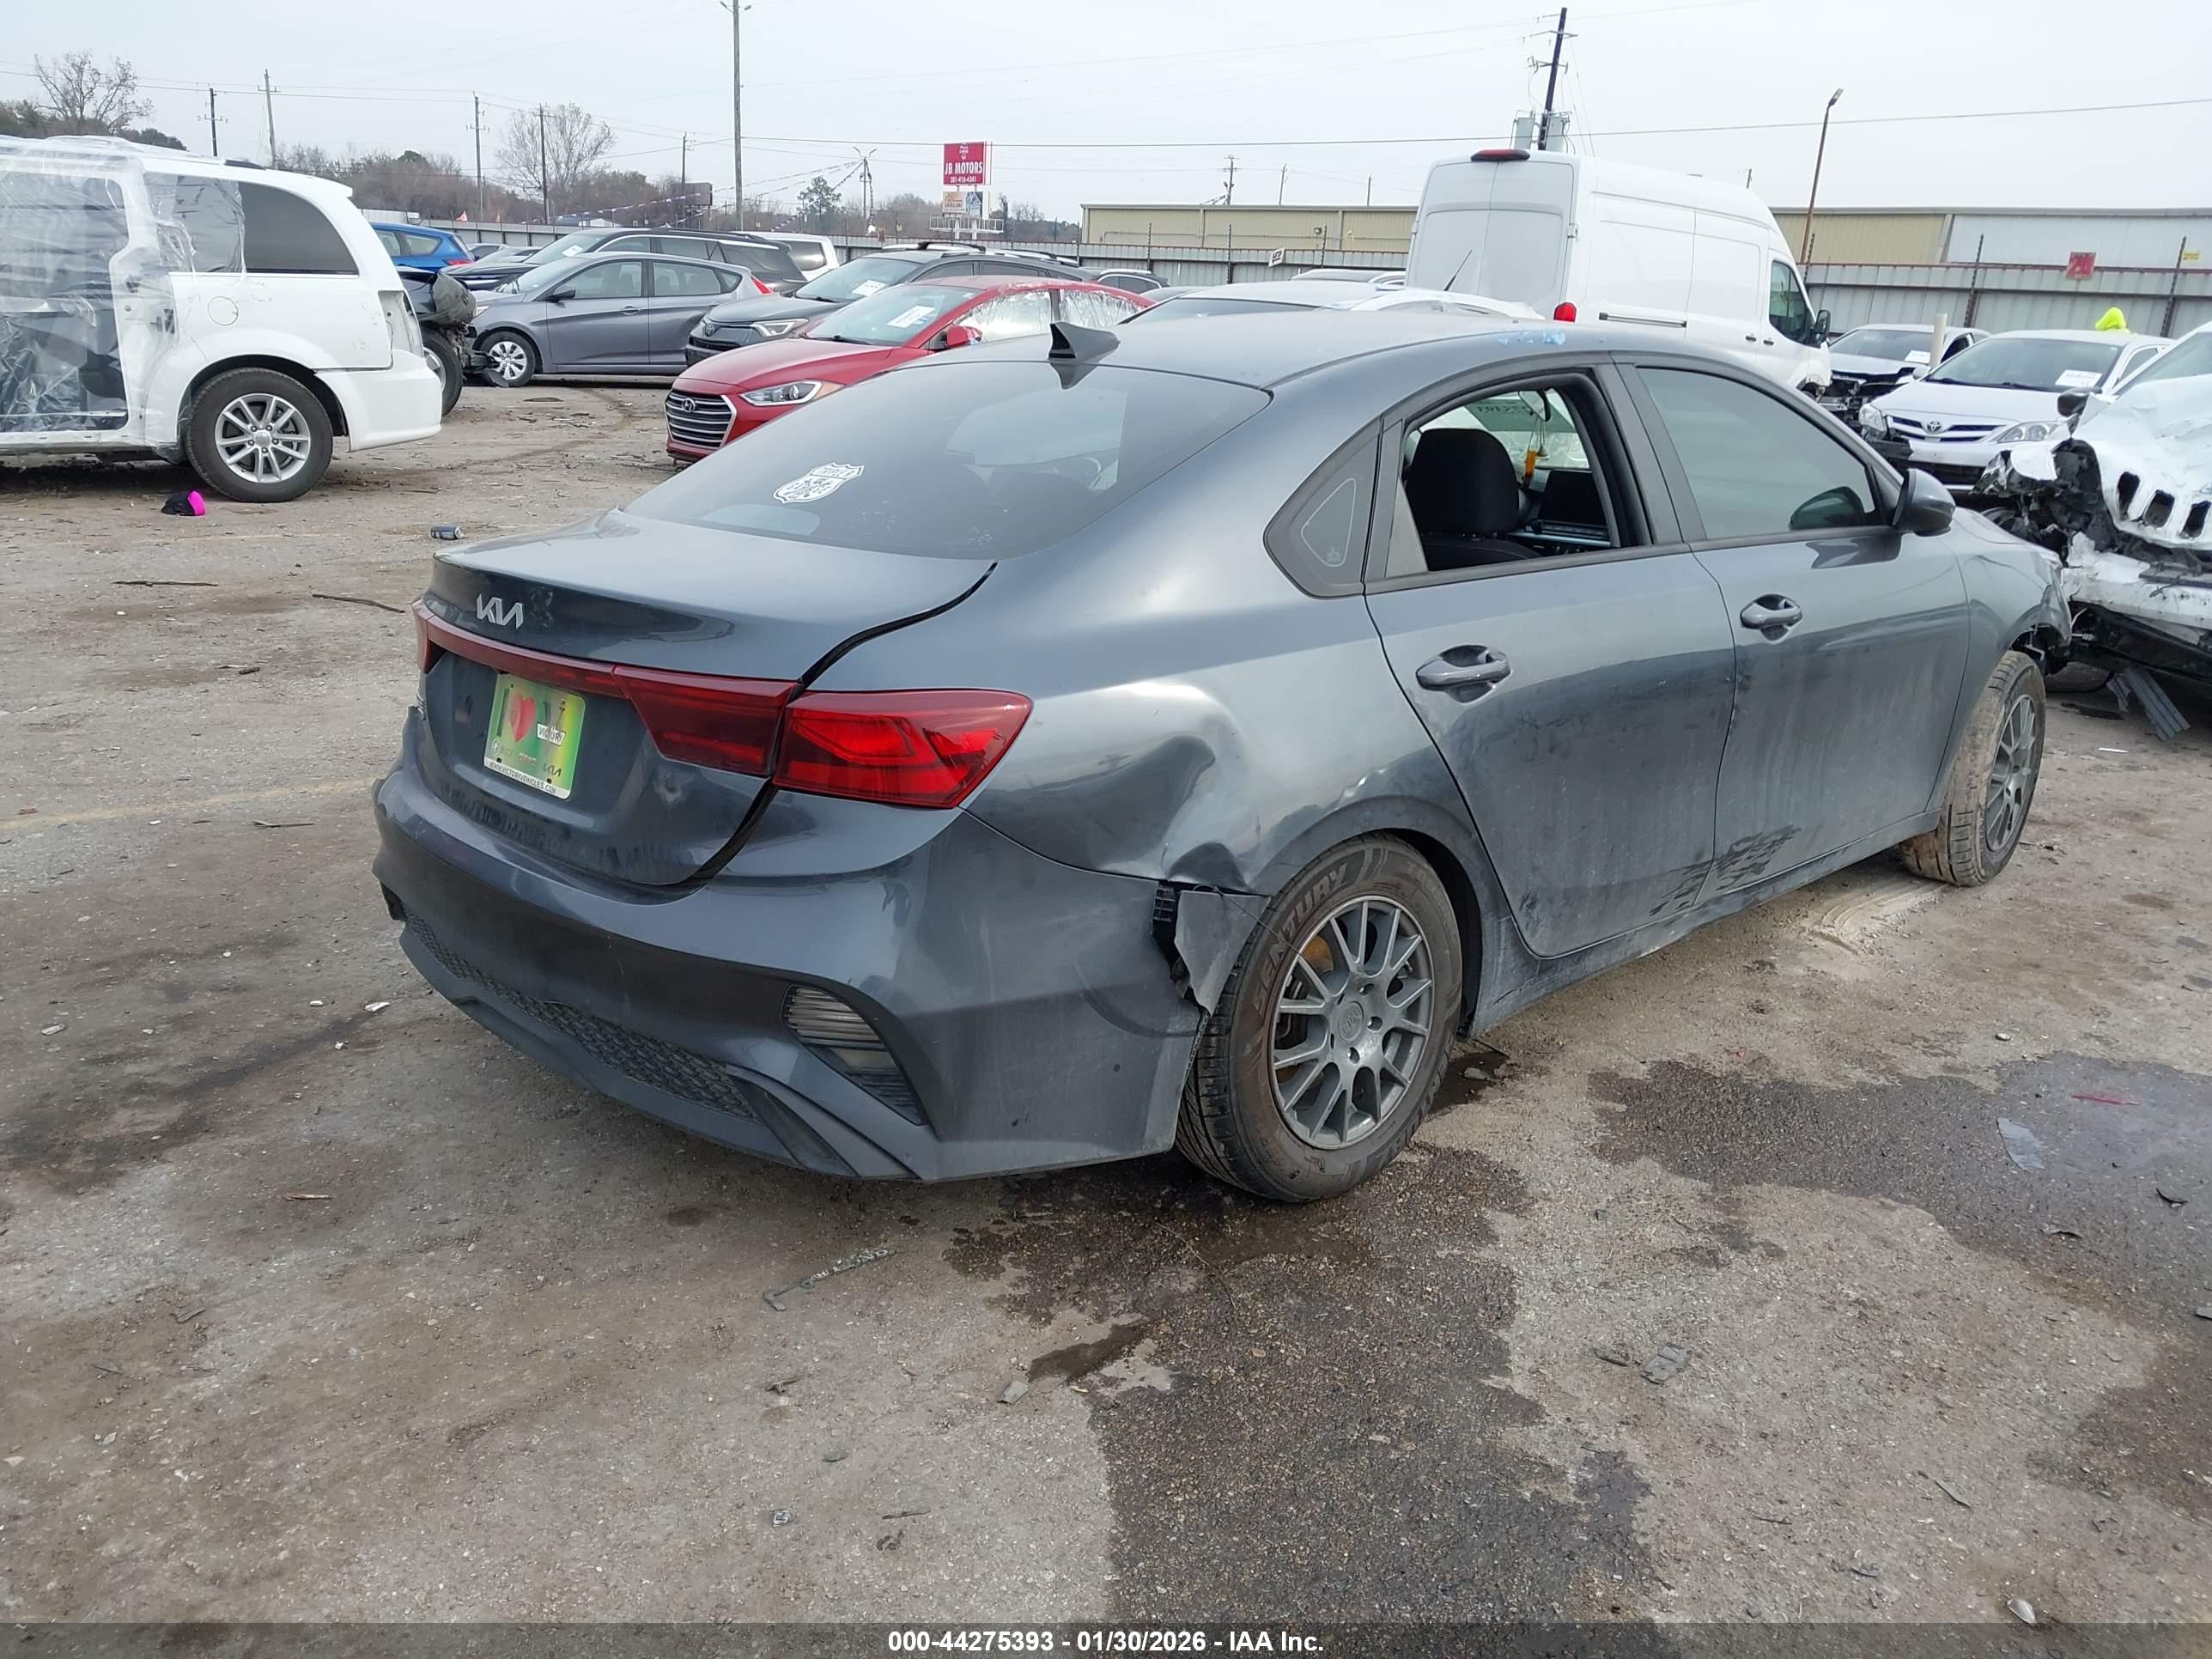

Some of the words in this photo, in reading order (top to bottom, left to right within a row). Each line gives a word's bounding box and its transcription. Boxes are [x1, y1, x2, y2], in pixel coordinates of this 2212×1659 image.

[945, 161, 953, 175] JB
[954, 161, 983, 174] MOTORS
[477, 593, 524, 629] KIA
[489, 762, 556, 794] WWW.VICTORYVEHICLES.COM
